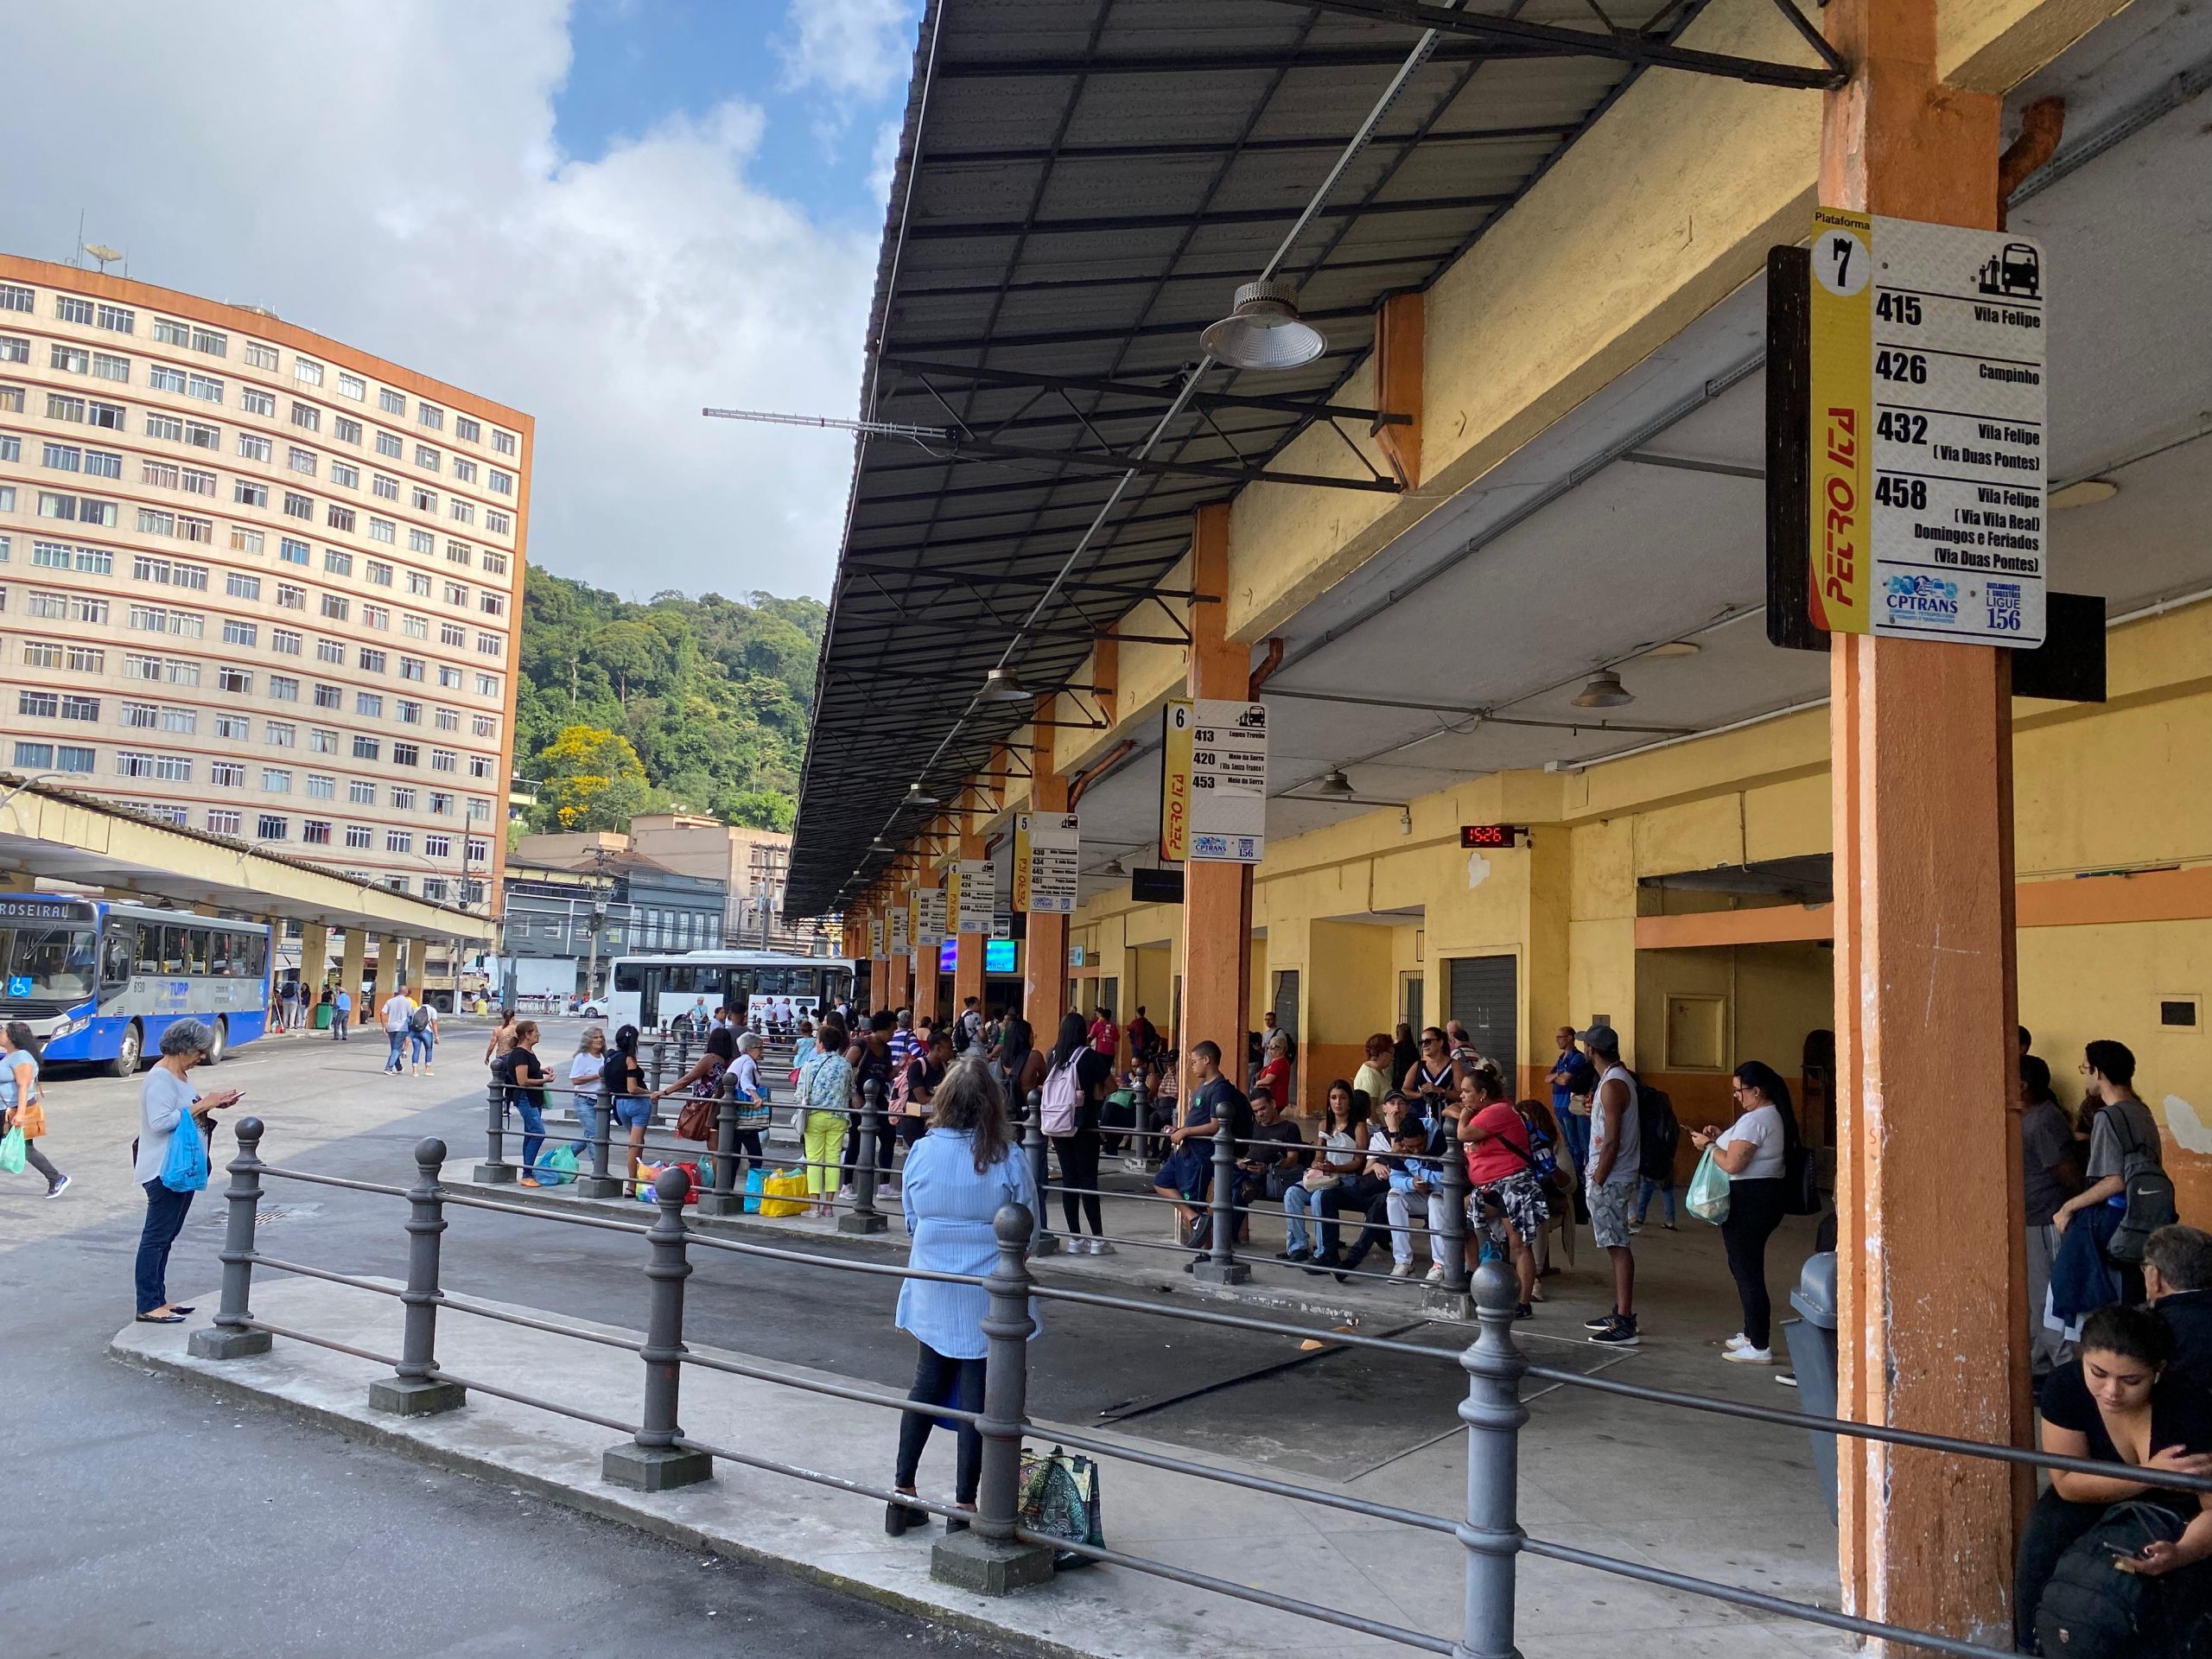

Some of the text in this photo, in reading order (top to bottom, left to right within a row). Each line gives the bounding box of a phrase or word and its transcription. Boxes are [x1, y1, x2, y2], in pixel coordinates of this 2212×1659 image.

[1815, 212, 1870, 231] Plataforma
[1833, 238, 1853, 287] 7
[1876, 293, 2040, 328] 415 Vila Felipe
[1875, 351, 2040, 385] 426 Campinho
[1877, 411, 2040, 446] 432 Vila Felipe
[1962, 448, 1992, 465] Duas
[1994, 452, 2040, 471] Pontes)
[1875, 477, 2040, 510] 458 Vila Felipe
[1982, 511, 2006, 528] Vila
[2009, 514, 2040, 531] Real)
[1827, 477, 1854, 607] PETRO
[1915, 524, 2039, 551] Domingos e Feriados
[1935, 548, 2038, 572] (Via Duas Pontes)
[1886, 594, 1958, 614] CPTRANS
[1986, 596, 2021, 609] LIGUE
[1986, 607, 2021, 631] 156
[1176, 709, 1185, 728] 6
[1194, 729, 1214, 742] 413
[1193, 753, 1215, 765] 420
[1192, 776, 1215, 788] 453
[1021, 817, 1027, 830] 5
[1470, 828, 1501, 842] 15:26
[1238, 849, 1254, 857] 156
[951, 865, 957, 874] 4
[0, 903, 68, 918] ROSEIRAL
[133, 982, 145, 994] 6130
[169, 982, 189, 995] TURP
